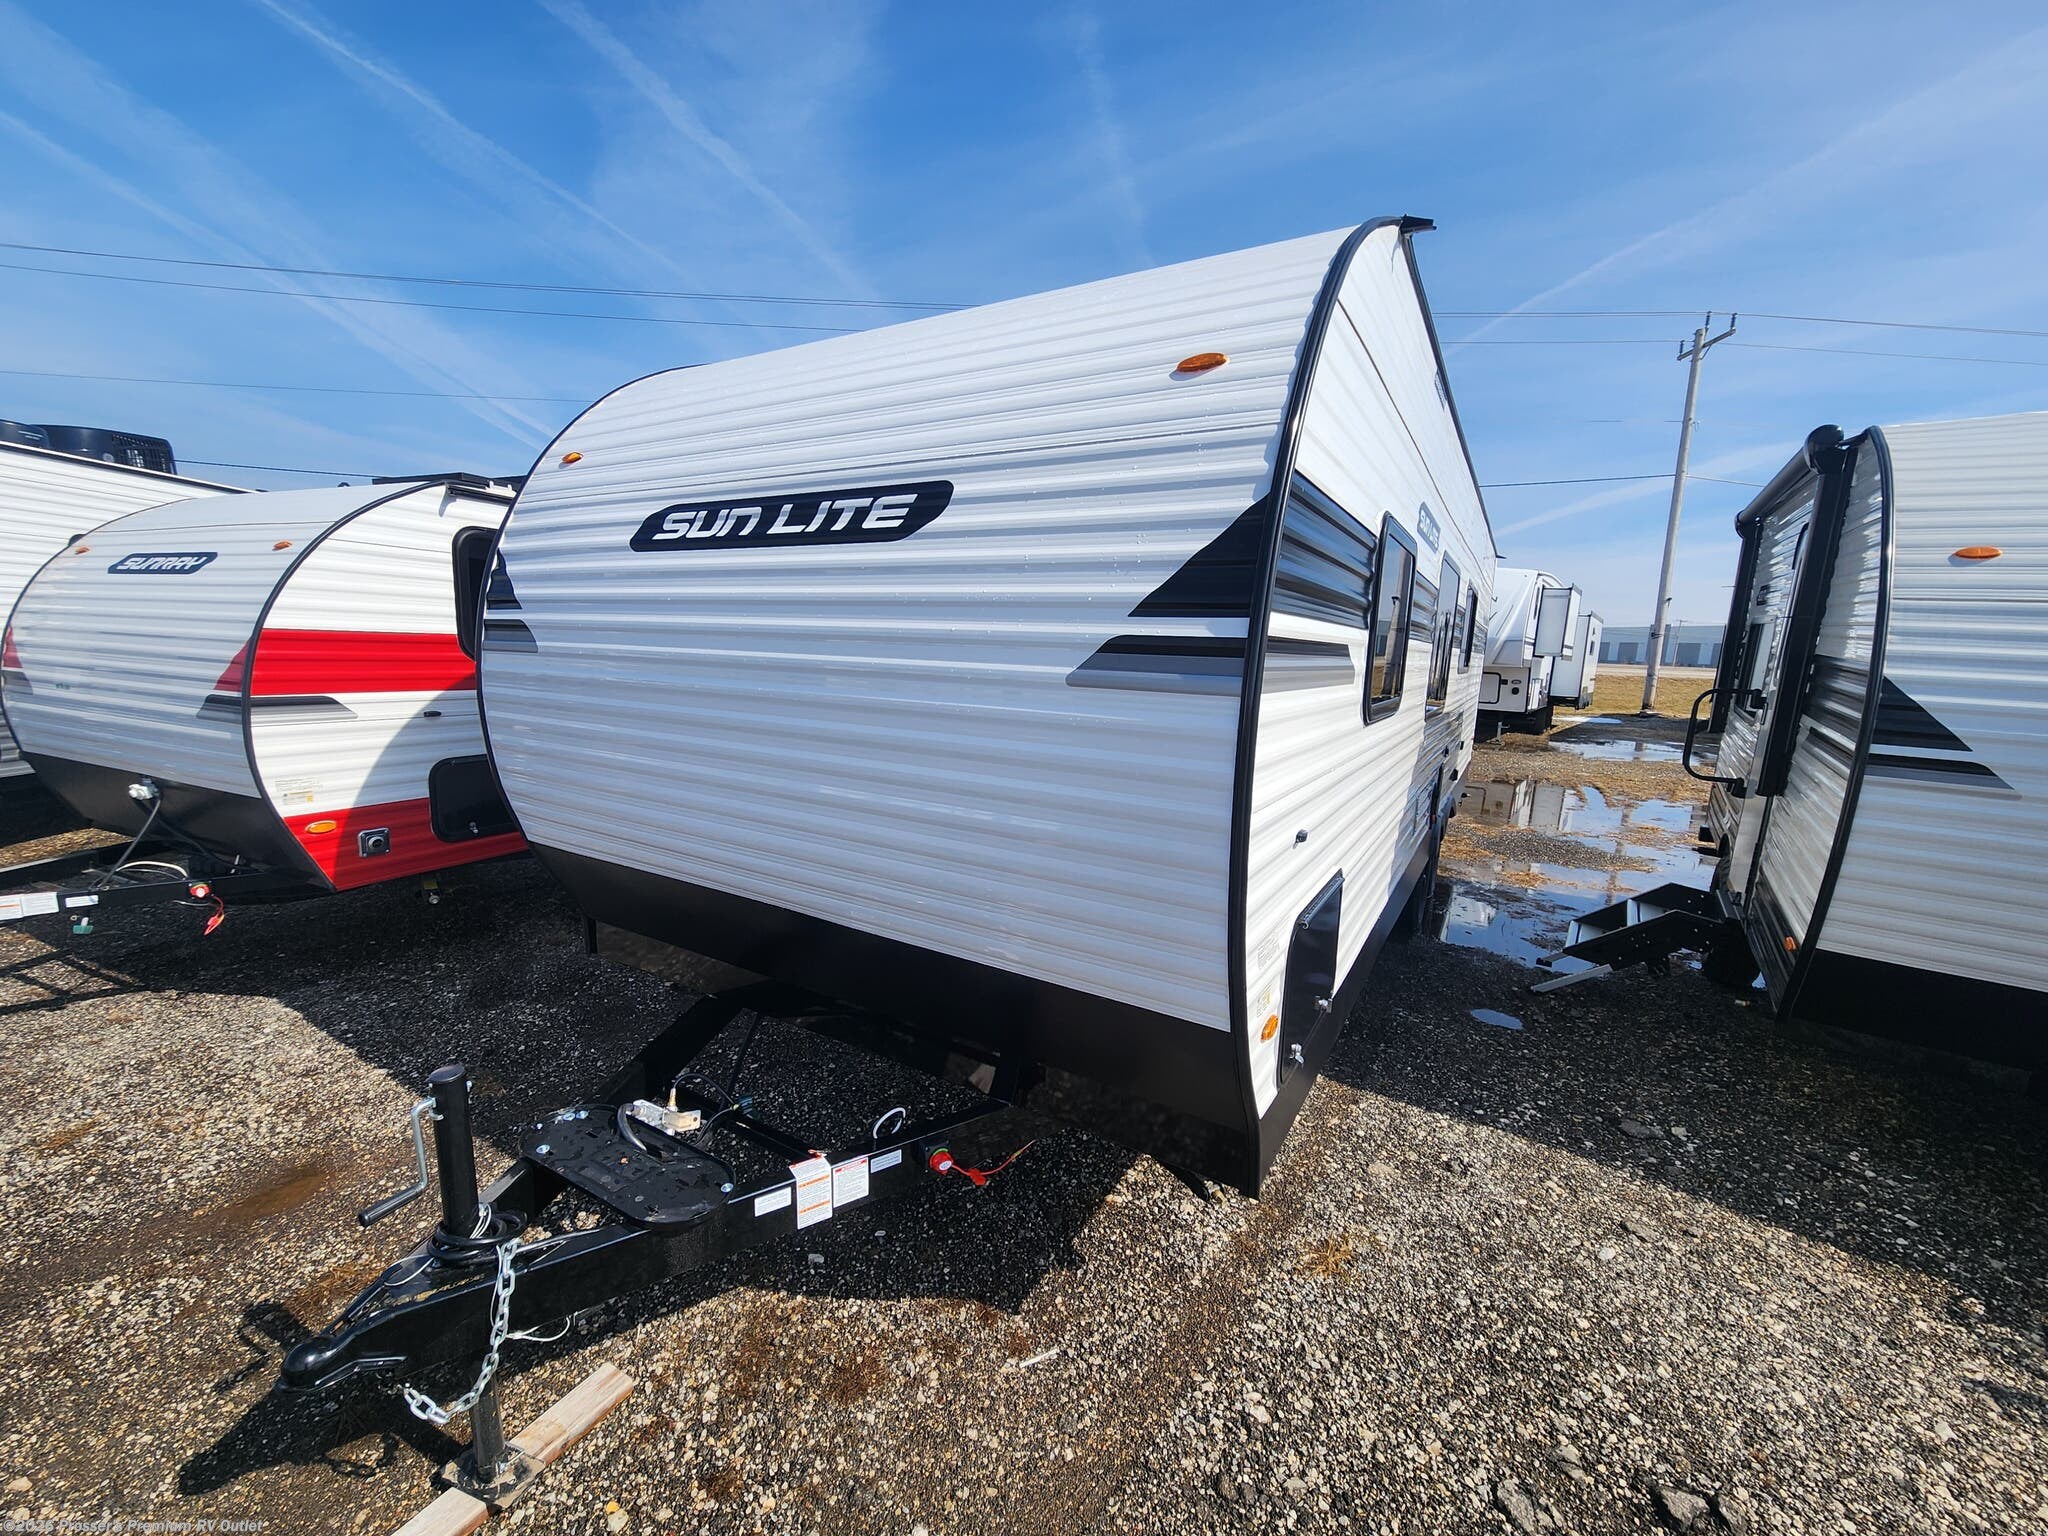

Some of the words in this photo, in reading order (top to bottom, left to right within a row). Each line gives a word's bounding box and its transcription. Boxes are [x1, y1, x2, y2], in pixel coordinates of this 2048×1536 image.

[652, 506, 762, 541] SUN
[766, 493, 918, 535] LITE
[116, 556, 208, 570] SUNRAY
